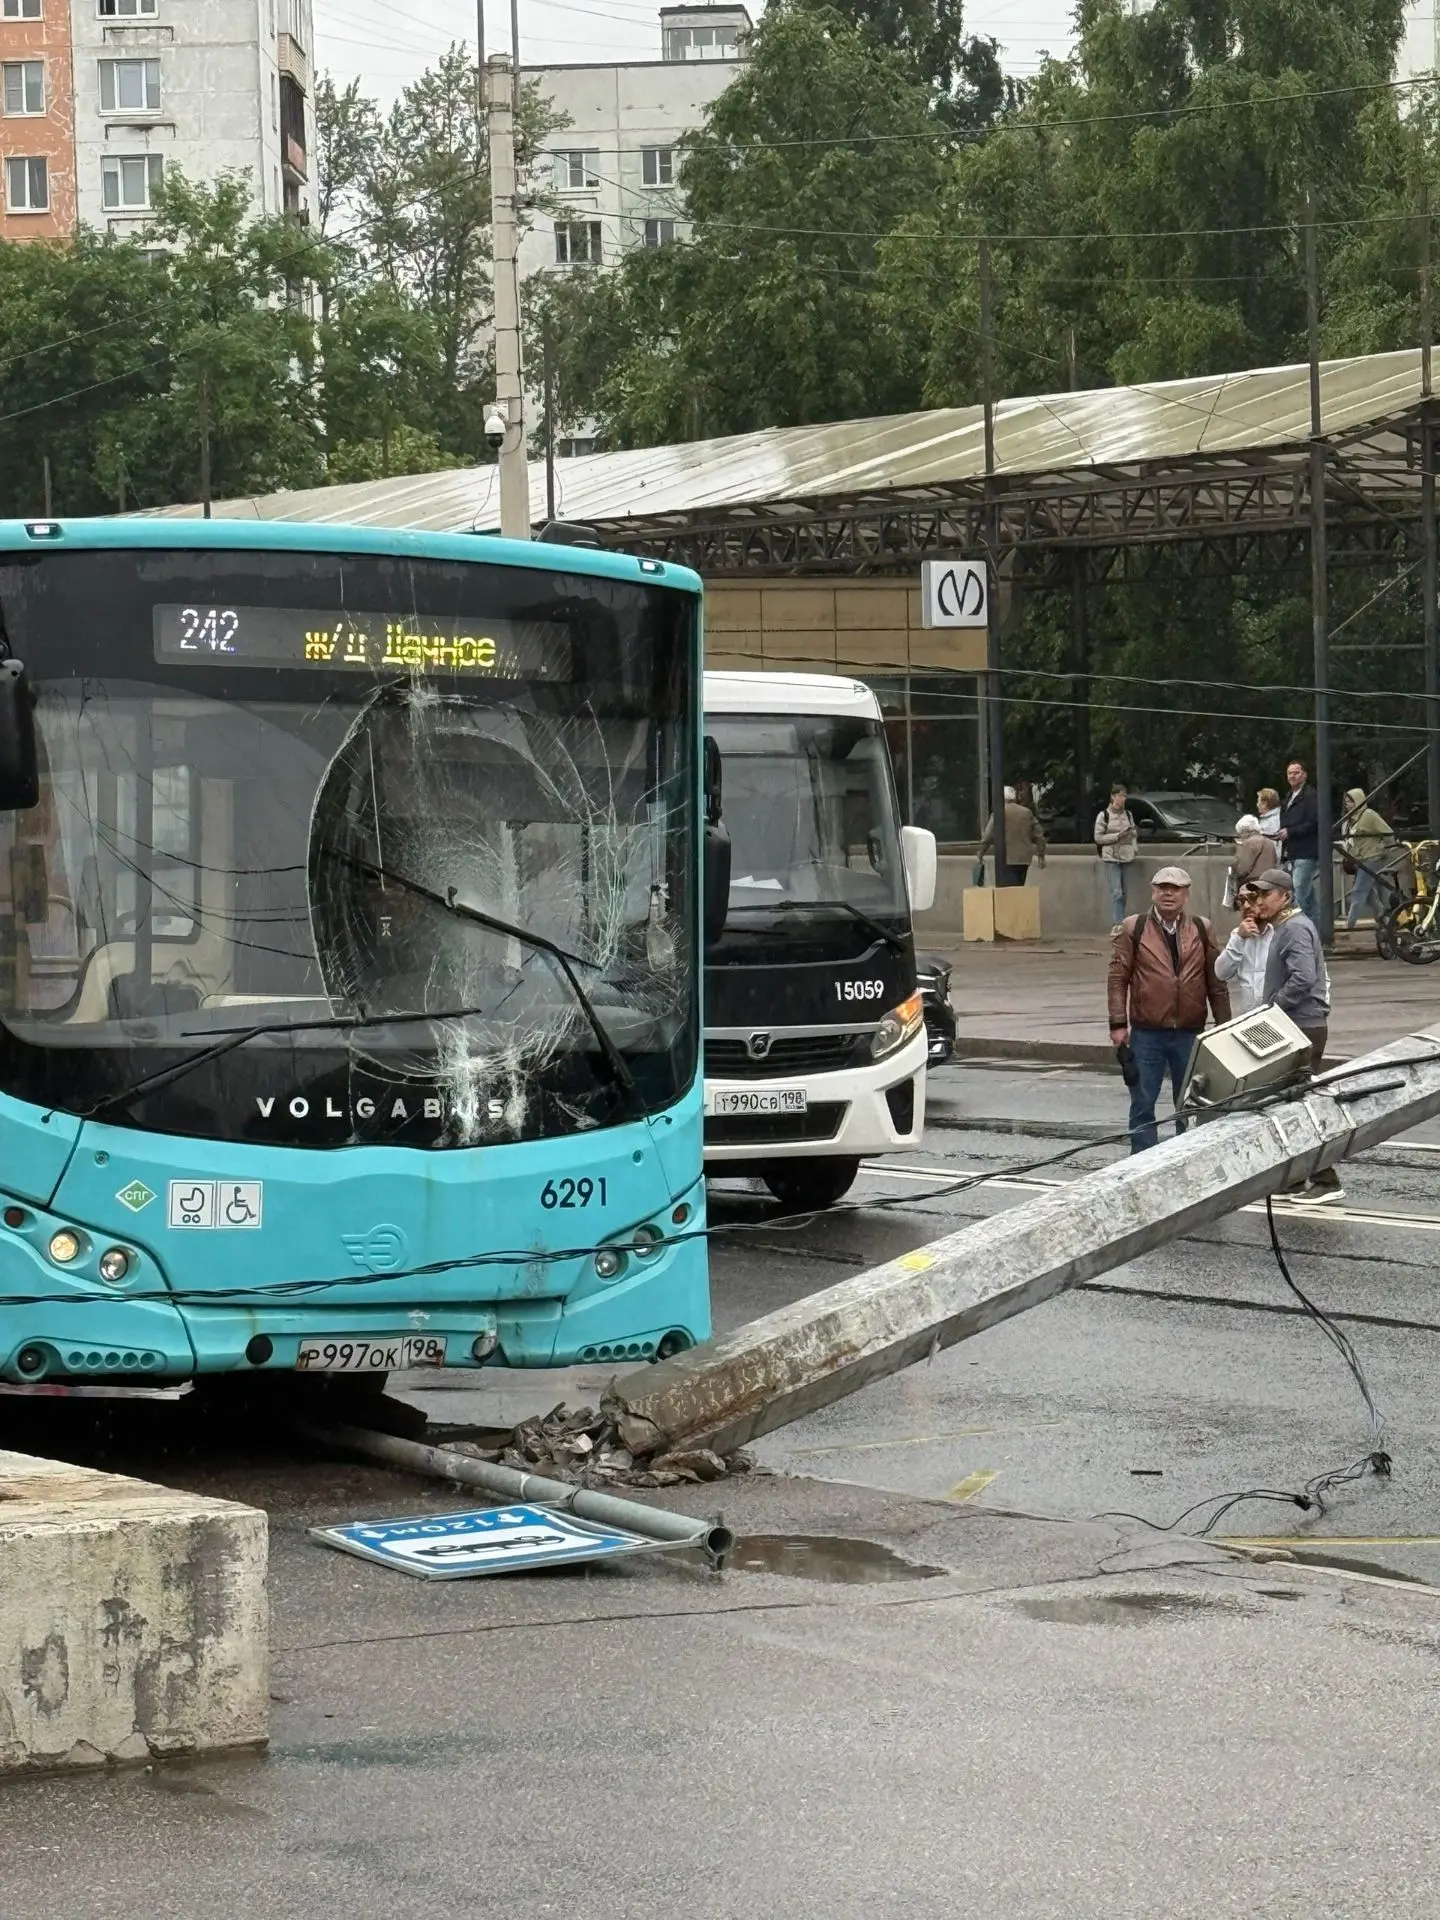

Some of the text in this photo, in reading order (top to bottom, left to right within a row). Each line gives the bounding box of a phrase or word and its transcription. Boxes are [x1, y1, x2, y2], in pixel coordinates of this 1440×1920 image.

[180, 609, 239, 651] 242
[381, 624, 496, 667] Дачное
[834, 980, 884, 1000] 15059
[541, 1177, 606, 1209] 6291
[404, 1338, 438, 1358] 198
